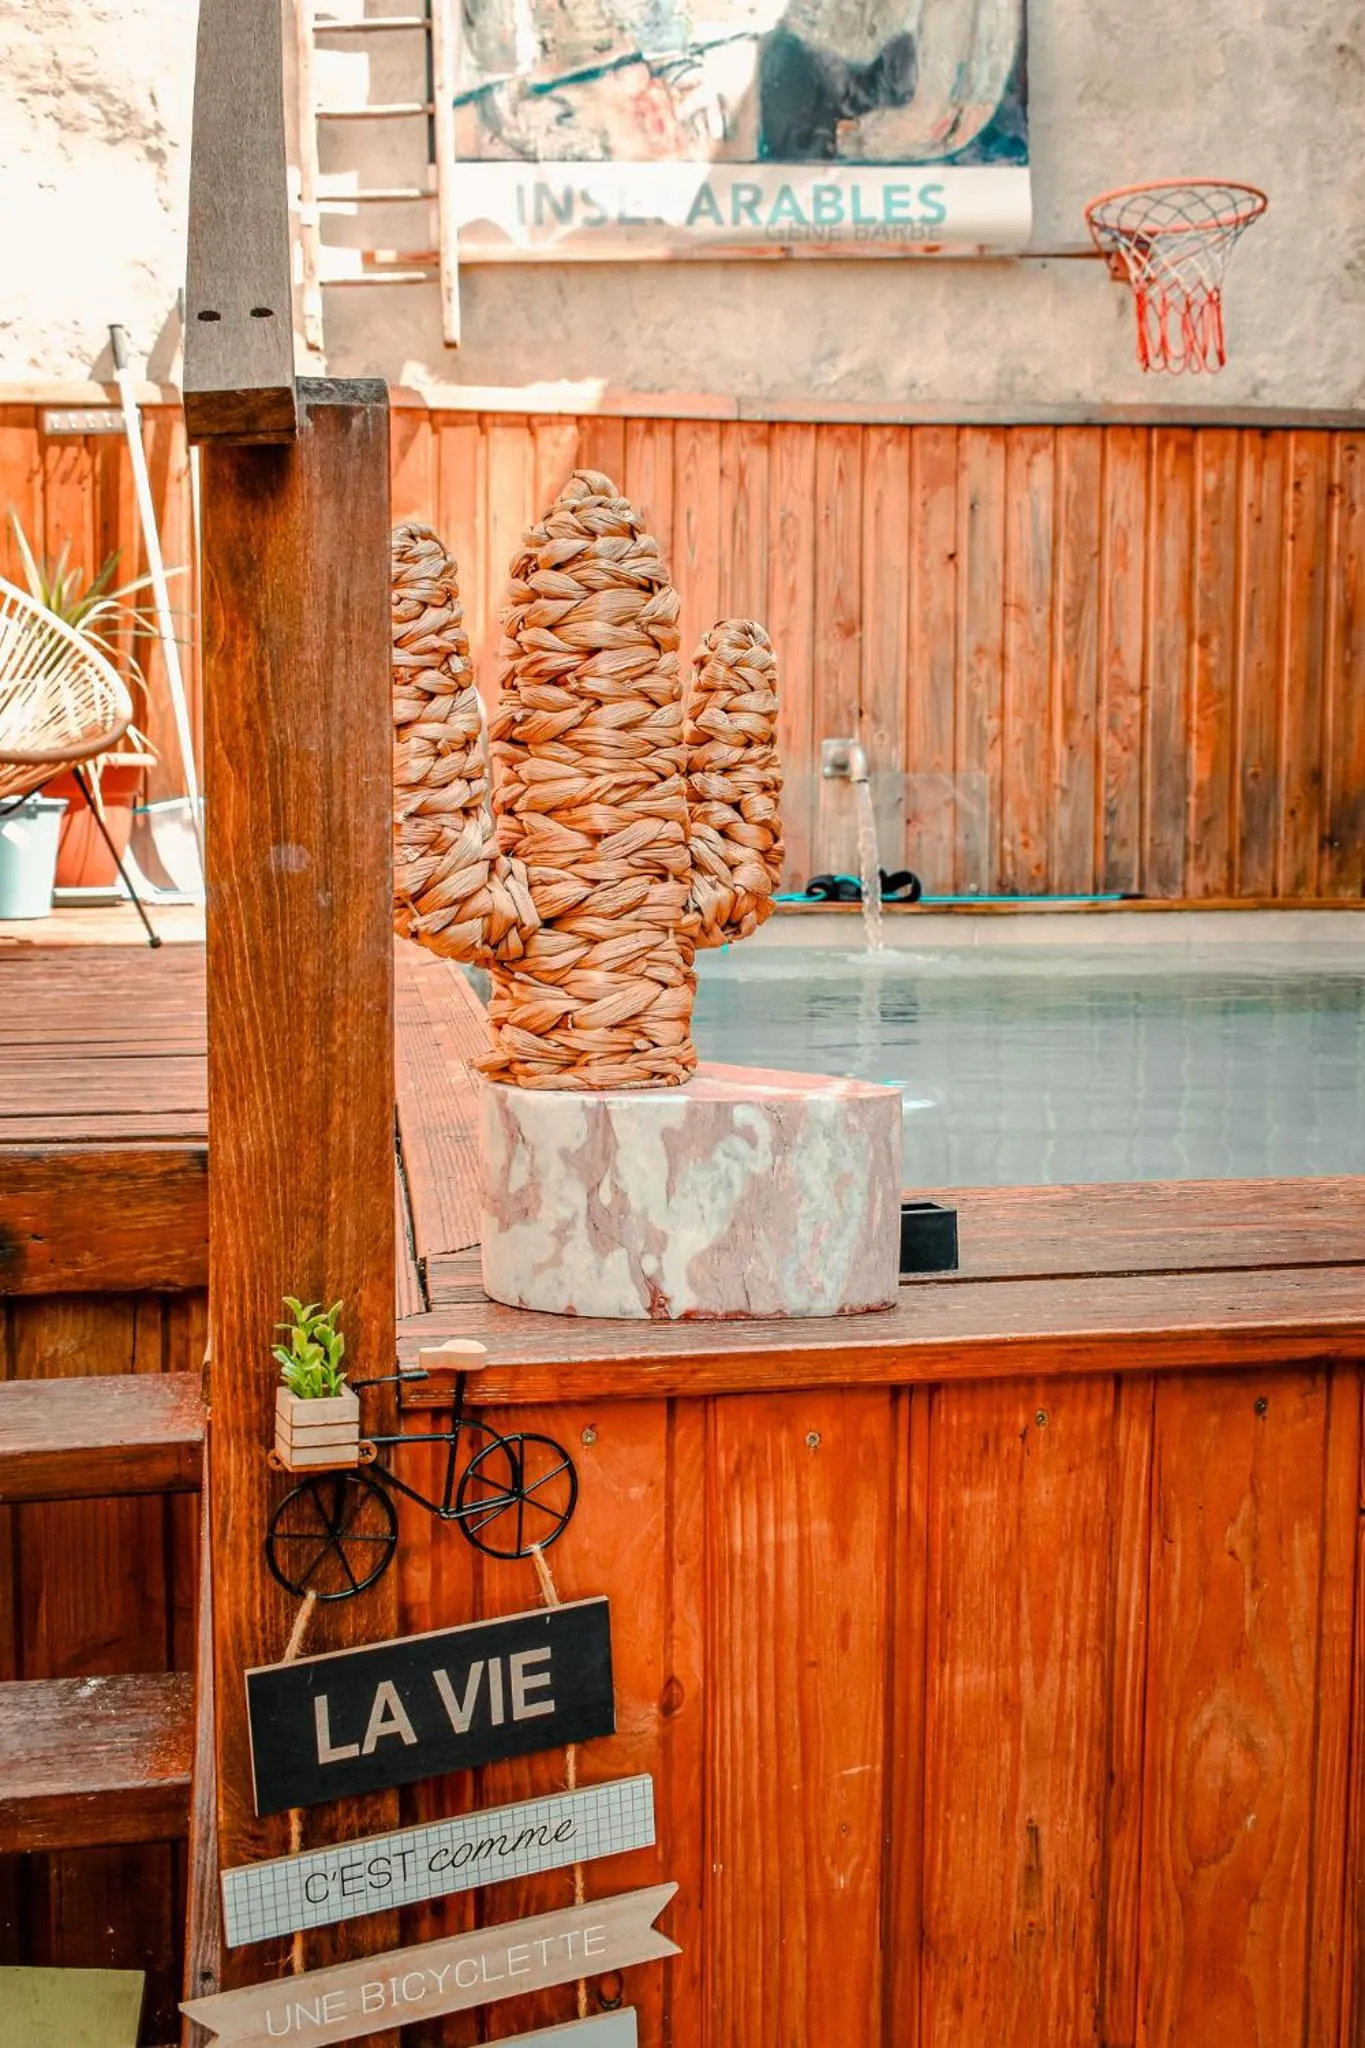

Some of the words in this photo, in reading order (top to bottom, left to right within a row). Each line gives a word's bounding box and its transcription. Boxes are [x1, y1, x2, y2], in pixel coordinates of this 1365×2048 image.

[516, 181, 948, 228] INSEARABLES
[313, 1680, 418, 1764] LA
[433, 1646, 556, 1734] VIE
[304, 1849, 416, 1904] C'EST
[428, 1817, 579, 1874] comme
[265, 1989, 348, 2038] UNE
[360, 1924, 608, 2015] BICYCLETTE
